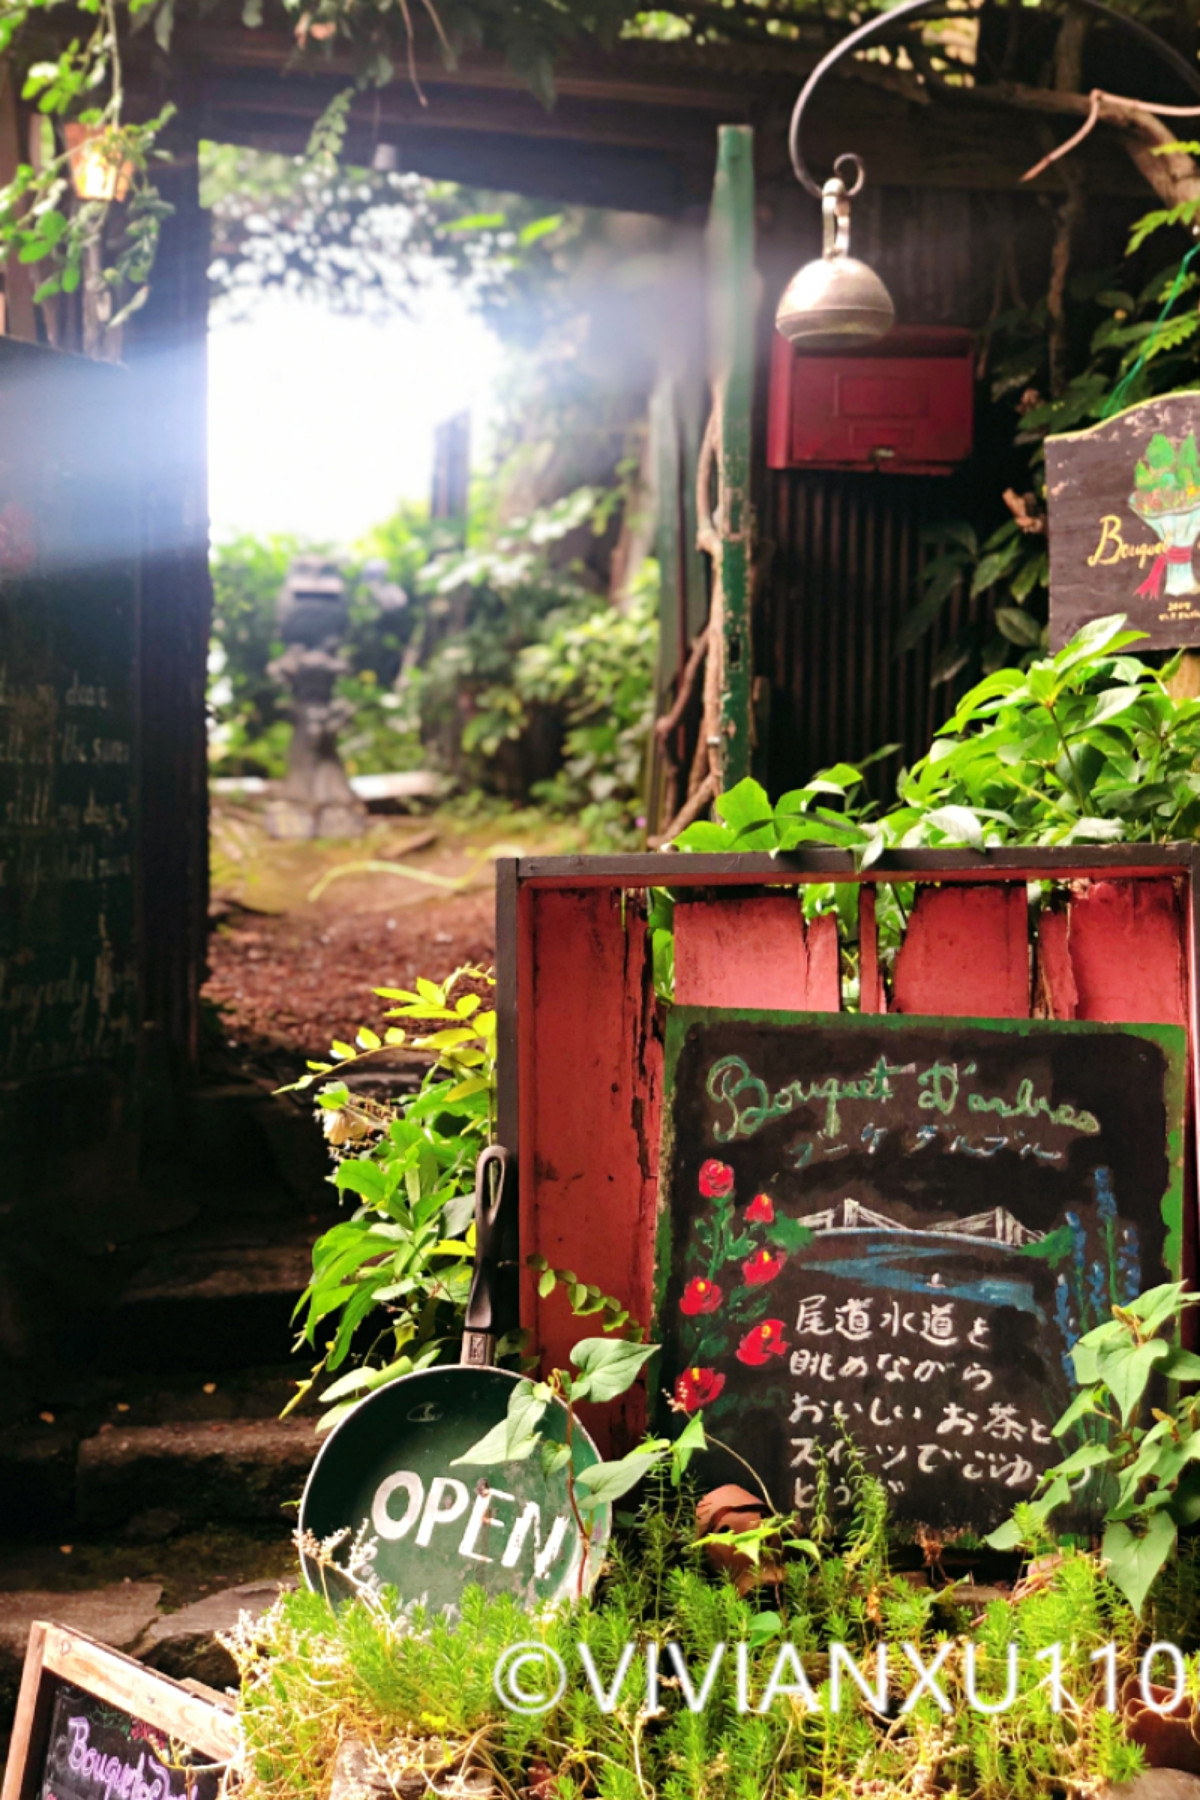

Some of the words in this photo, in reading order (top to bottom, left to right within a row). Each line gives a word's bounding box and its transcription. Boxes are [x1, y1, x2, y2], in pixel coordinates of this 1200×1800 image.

[706, 1054, 917, 1143] Bouquet
[794, 1295, 991, 1350] 尾道水道を
[789, 1349, 994, 1391] 眺めながら
[371, 1469, 571, 1580] OPEN
